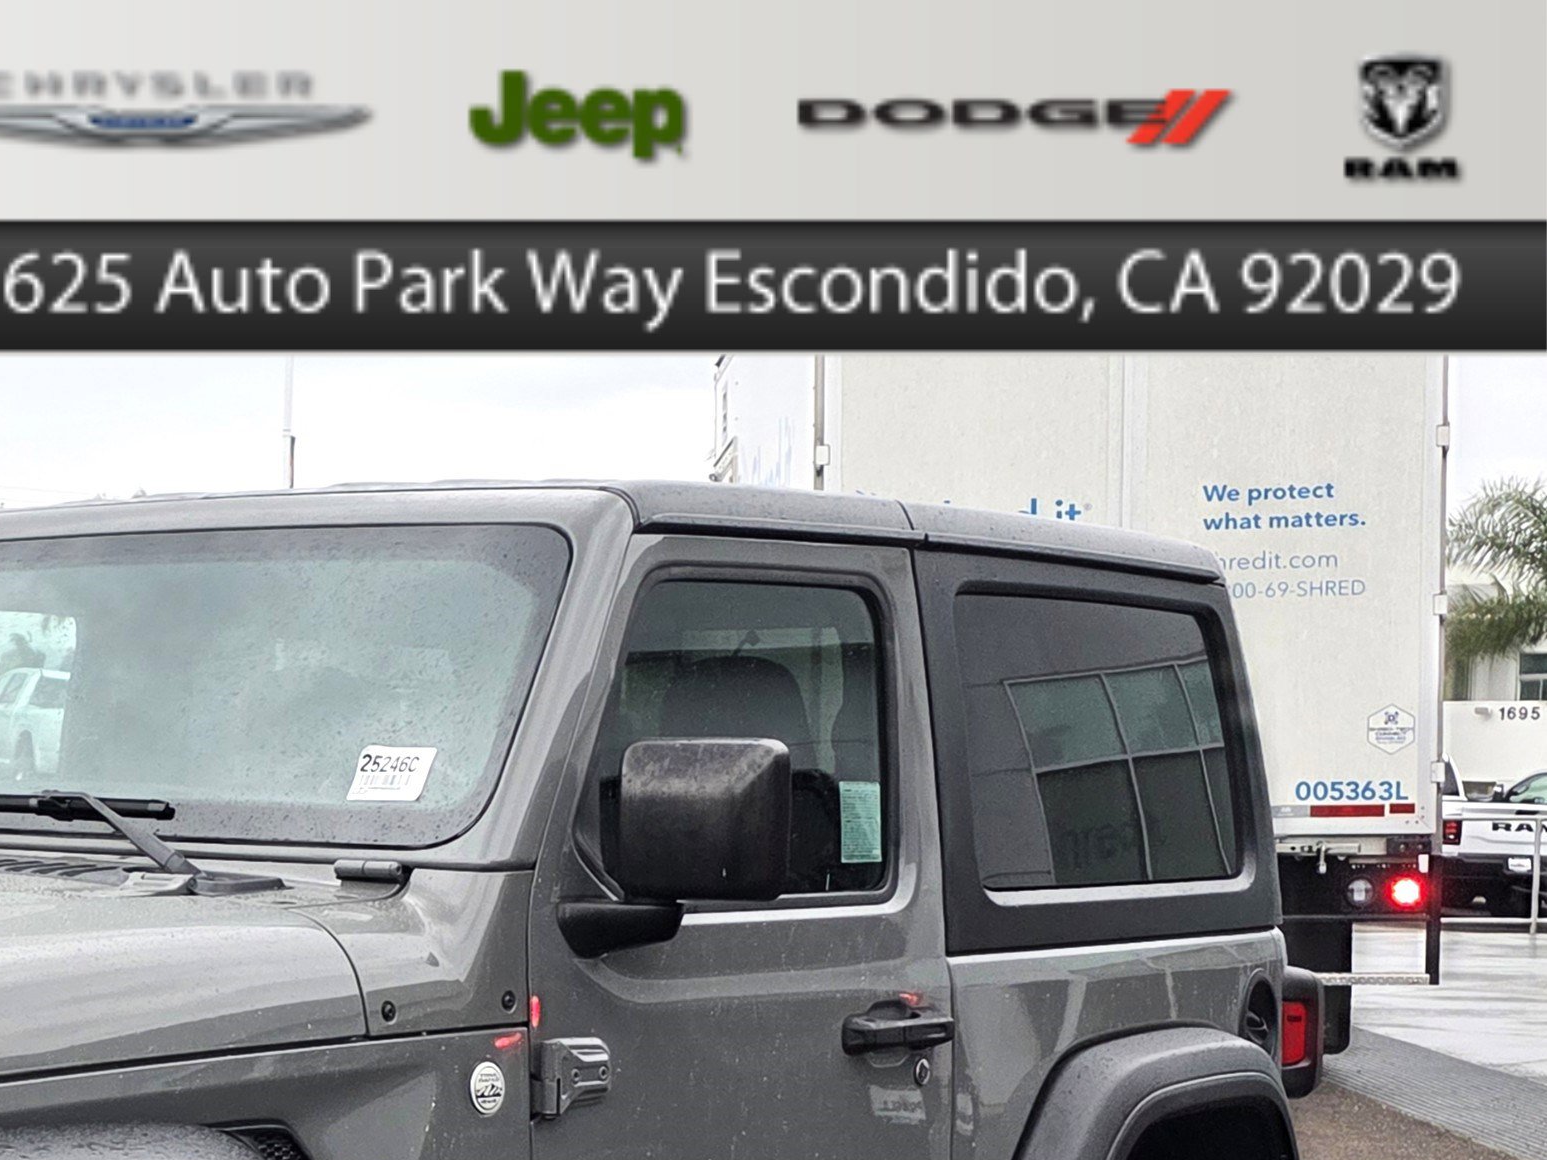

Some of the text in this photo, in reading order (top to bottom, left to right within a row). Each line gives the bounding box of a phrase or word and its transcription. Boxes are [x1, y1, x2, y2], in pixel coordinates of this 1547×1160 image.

[1202, 482, 1335, 506] We protect
[1203, 510, 1366, 530] what matters.
[1215, 550, 1339, 571] hredit.com
[1228, 579, 1366, 600] 00-69-SHRED
[1498, 706, 1541, 721] 1695
[1295, 780, 1410, 802] 005363L
